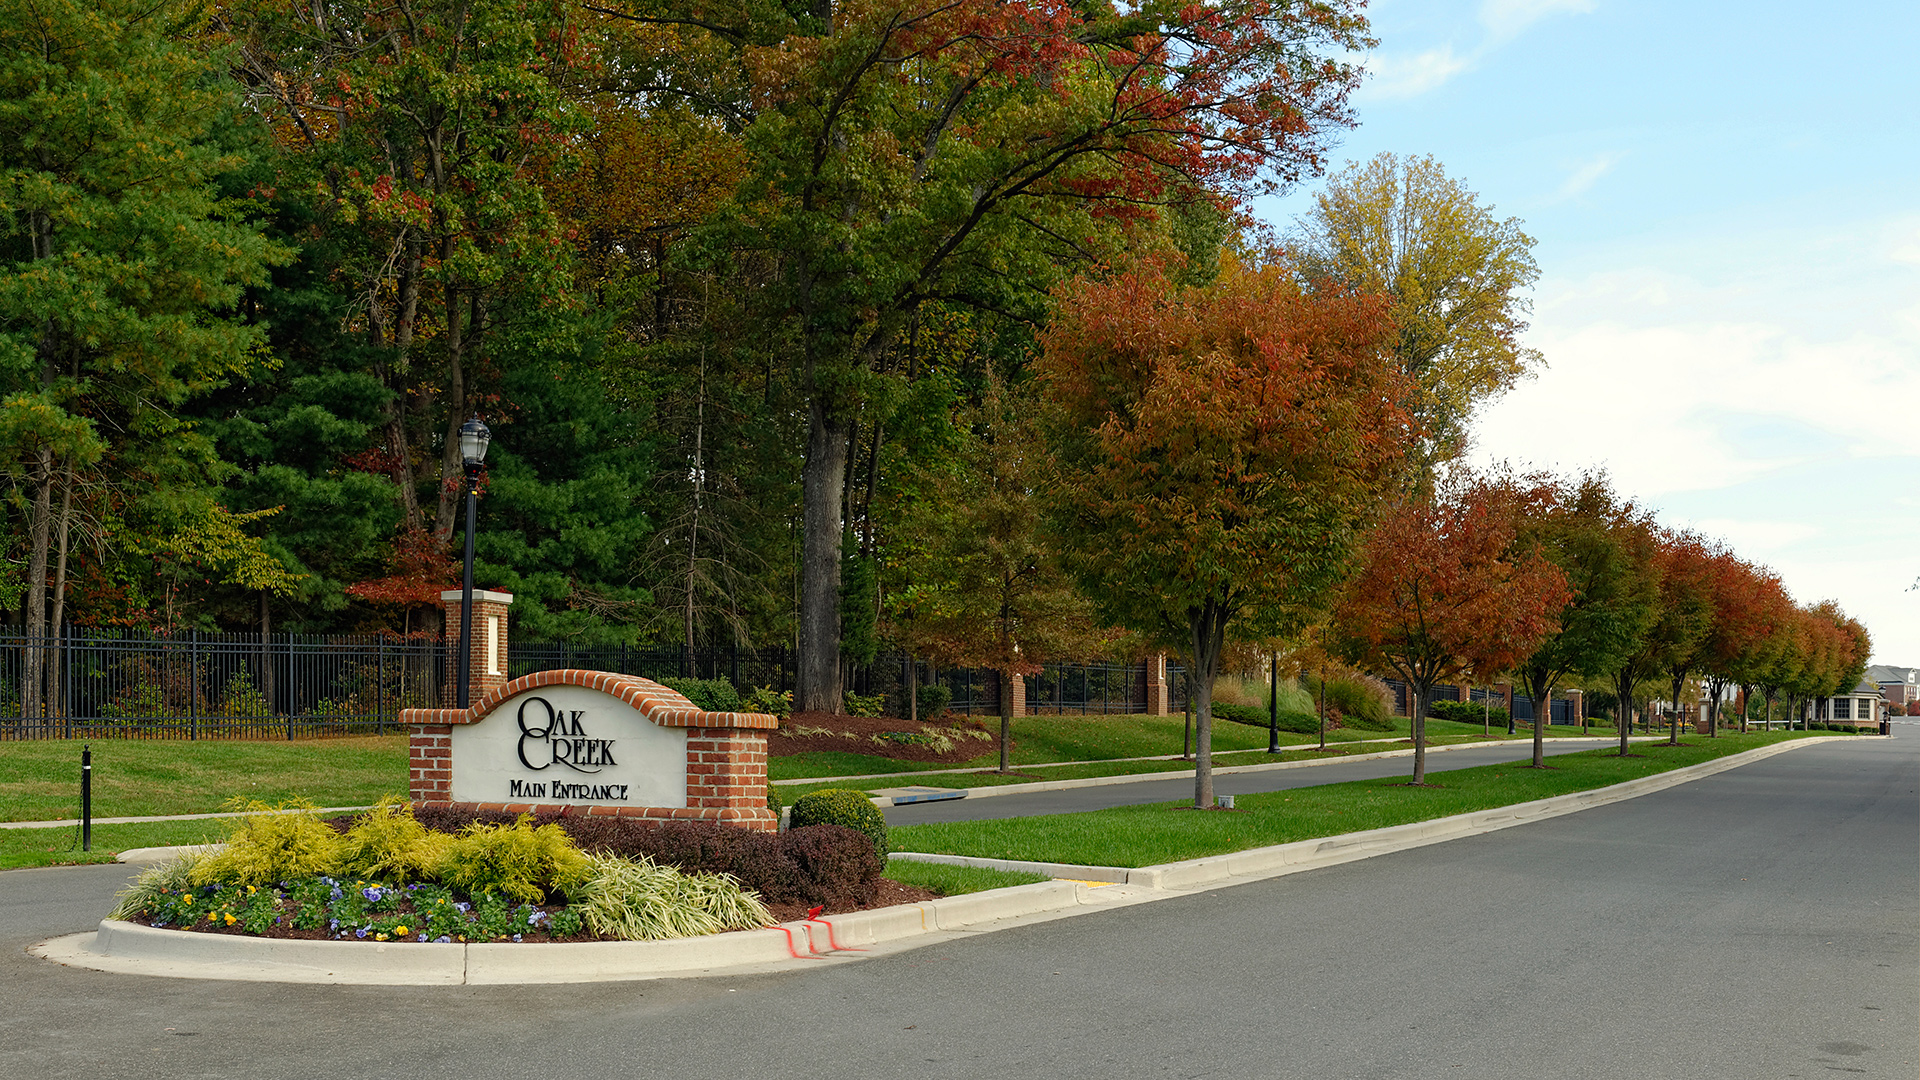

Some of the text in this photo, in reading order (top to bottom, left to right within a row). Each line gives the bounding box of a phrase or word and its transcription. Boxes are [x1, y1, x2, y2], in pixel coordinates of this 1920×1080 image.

[517, 696, 588, 741] OAK
[517, 728, 618, 774] CREEK
[509, 779, 628, 801] MAIN ENTRANCE
